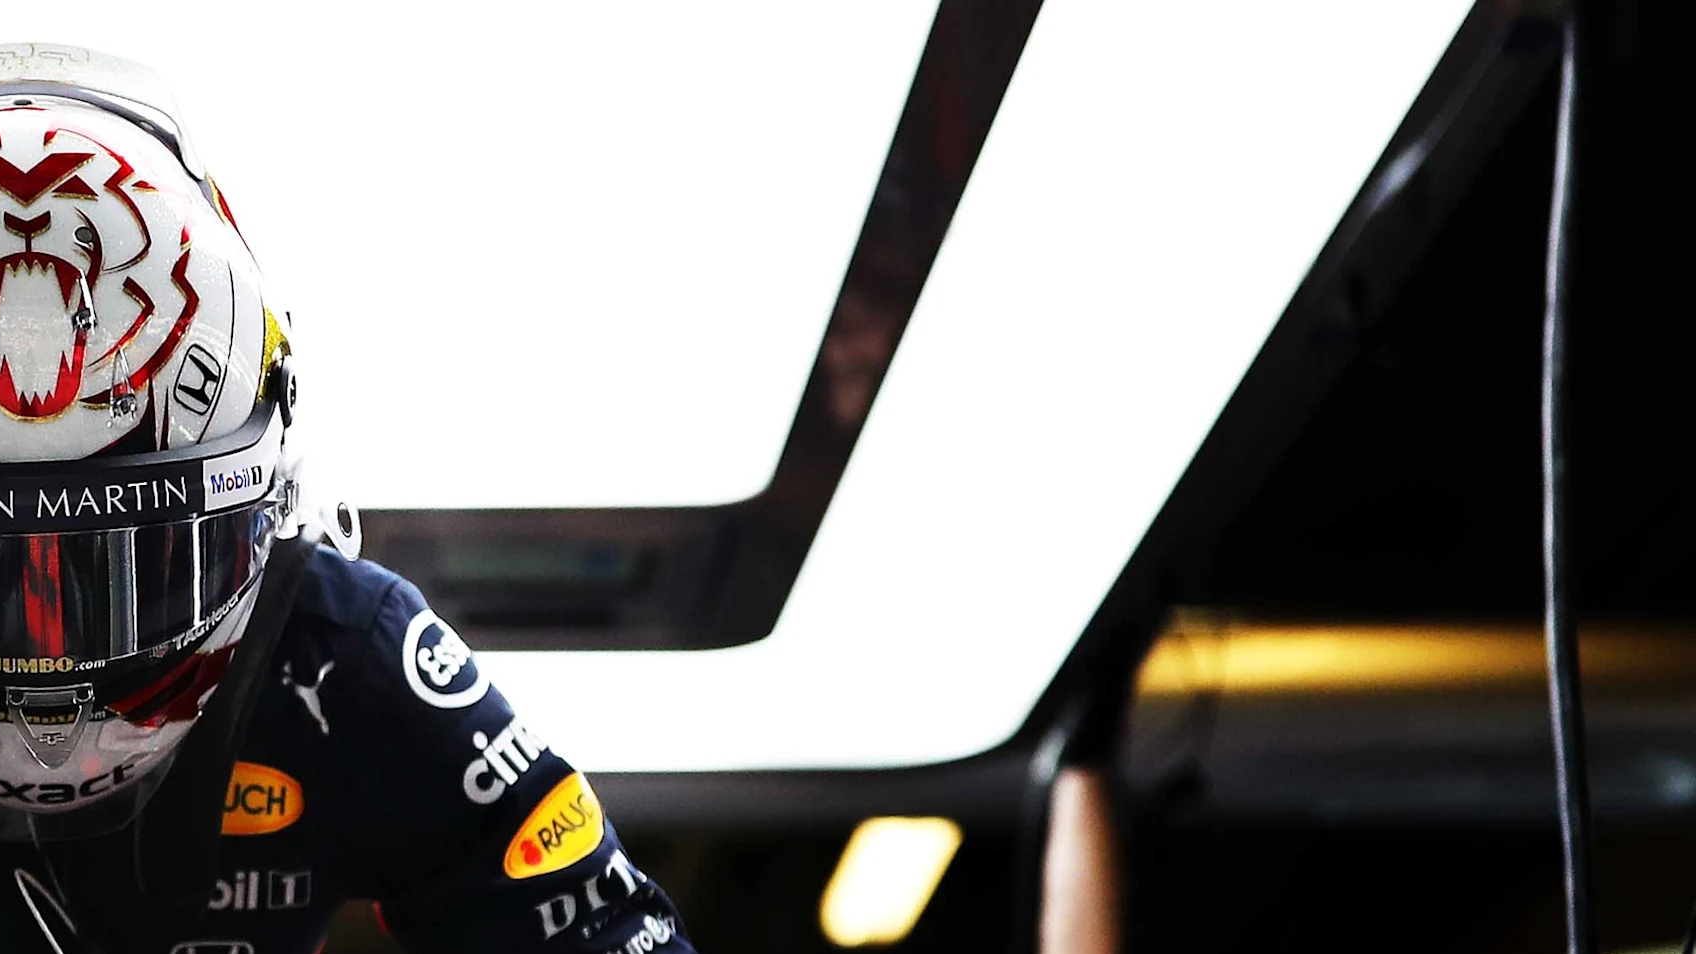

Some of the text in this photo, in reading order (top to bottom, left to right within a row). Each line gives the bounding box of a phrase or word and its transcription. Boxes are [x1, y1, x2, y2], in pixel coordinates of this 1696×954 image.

[36, 475, 187, 519] MARTIN
[210, 468, 250, 495] Mobil
[224, 784, 287, 816] UCH
[538, 792, 594, 855] RAUC
[534, 848, 649, 941] DIT
